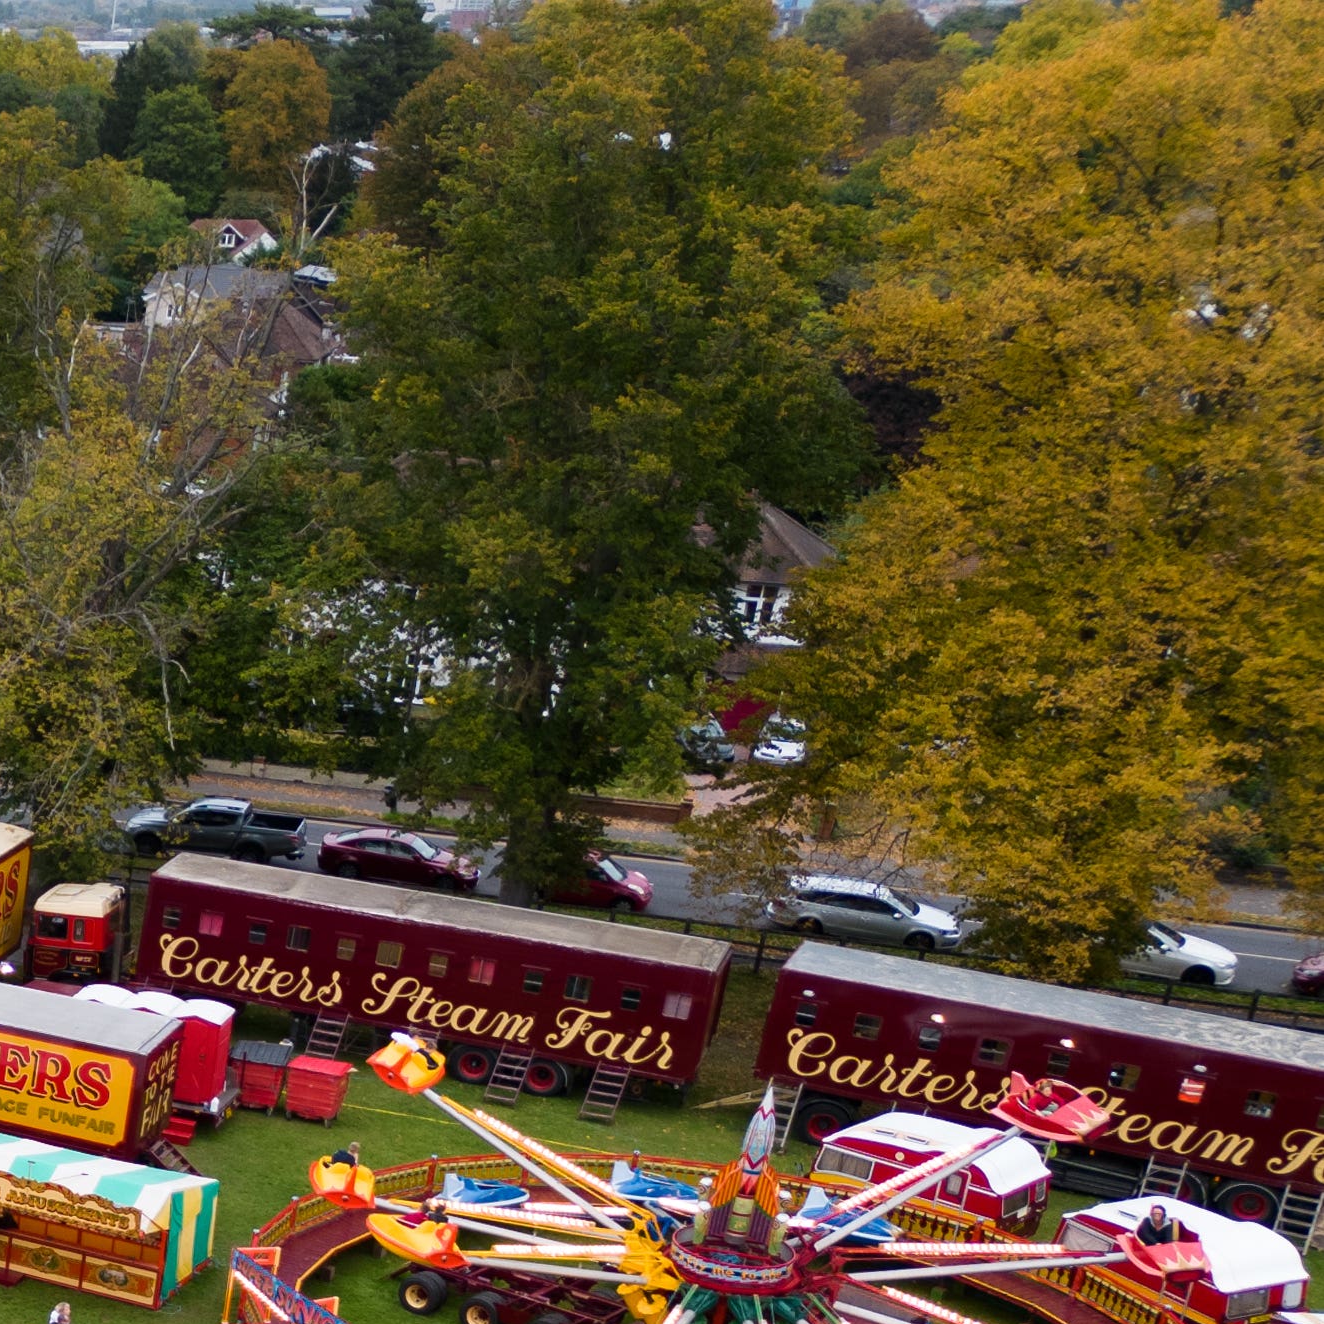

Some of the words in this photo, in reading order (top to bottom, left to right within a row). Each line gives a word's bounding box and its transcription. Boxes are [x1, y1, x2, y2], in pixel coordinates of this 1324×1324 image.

[159, 933, 343, 1007] Carters
[361, 972, 536, 1046] Steam
[545, 1006, 675, 1071] Fair
[147, 1040, 180, 1082] COME
[37, 1106, 116, 1137] FUNFAIR
[5, 1188, 131, 1230] AMUSEMENTS
